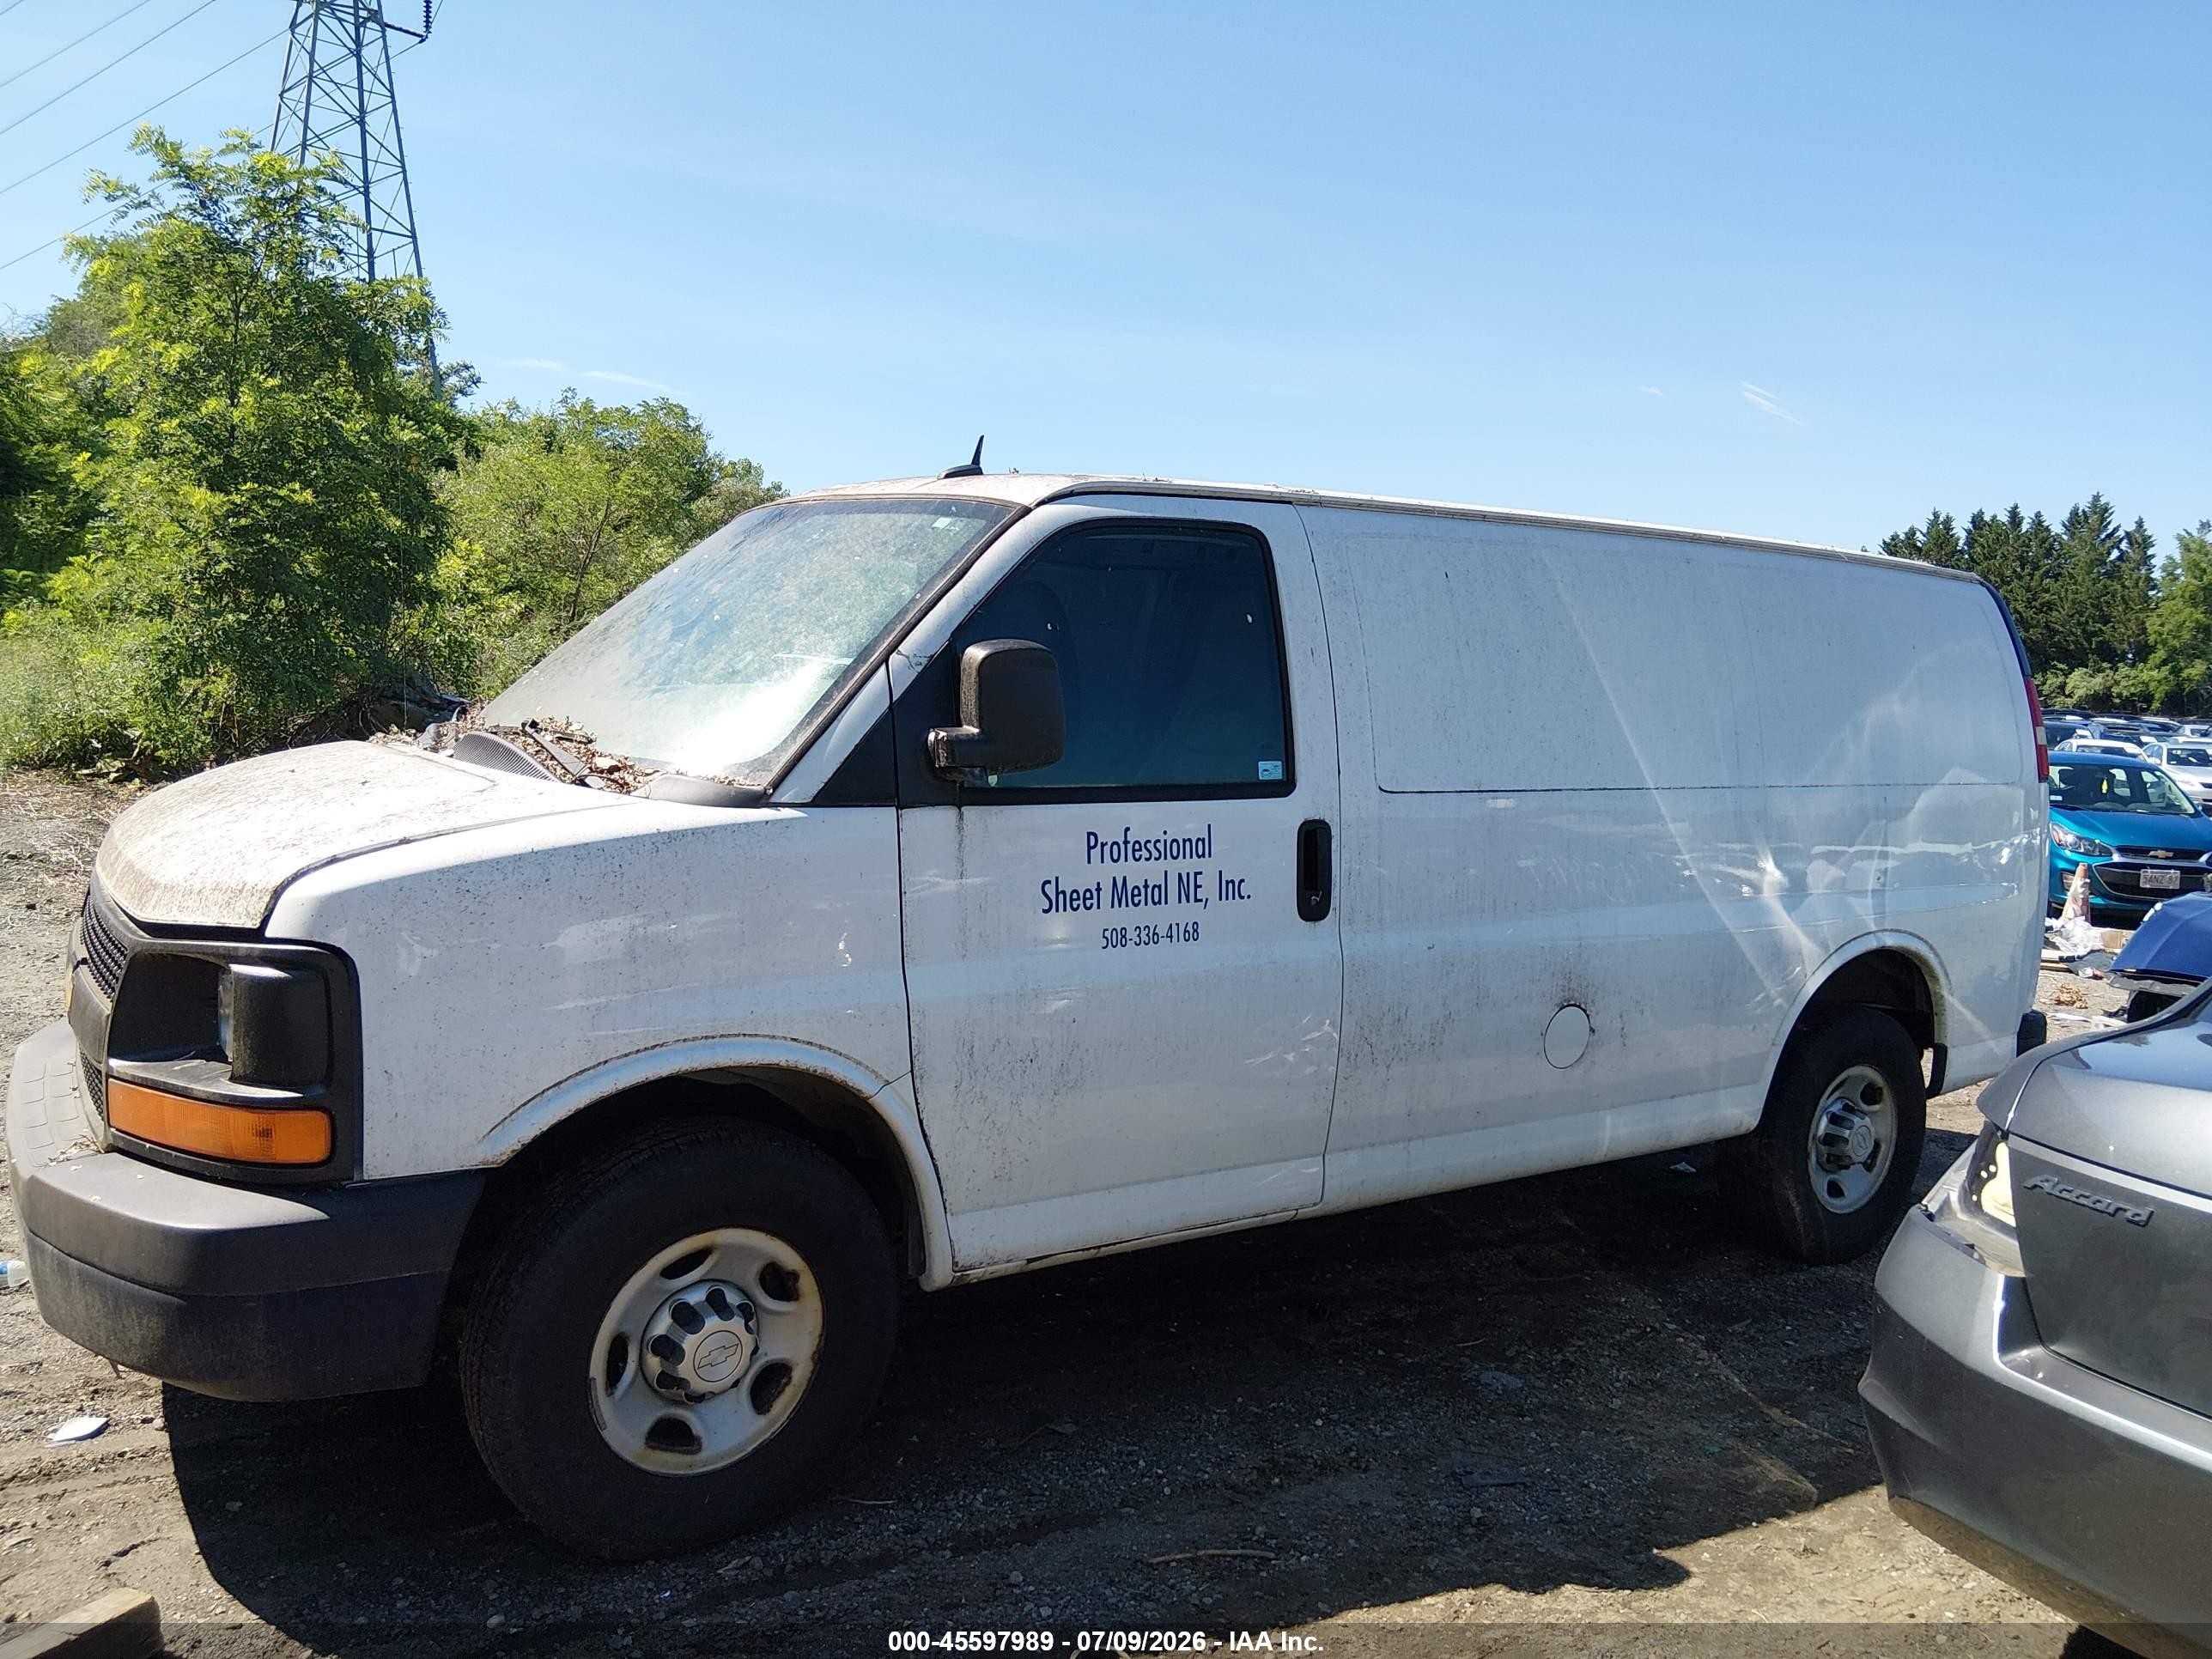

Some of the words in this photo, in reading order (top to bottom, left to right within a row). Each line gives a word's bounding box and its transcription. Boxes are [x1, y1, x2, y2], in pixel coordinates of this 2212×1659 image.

[1086, 824, 1212, 864] Professional
[1041, 876, 1103, 914] Sheet
[1111, 871, 1169, 908] Metal
[1177, 871, 1209, 909] NE,
[1218, 870, 1252, 901] Inc.
[1102, 921, 1200, 949] 508-336-4168
[2023, 1175, 2154, 1227] Accord
